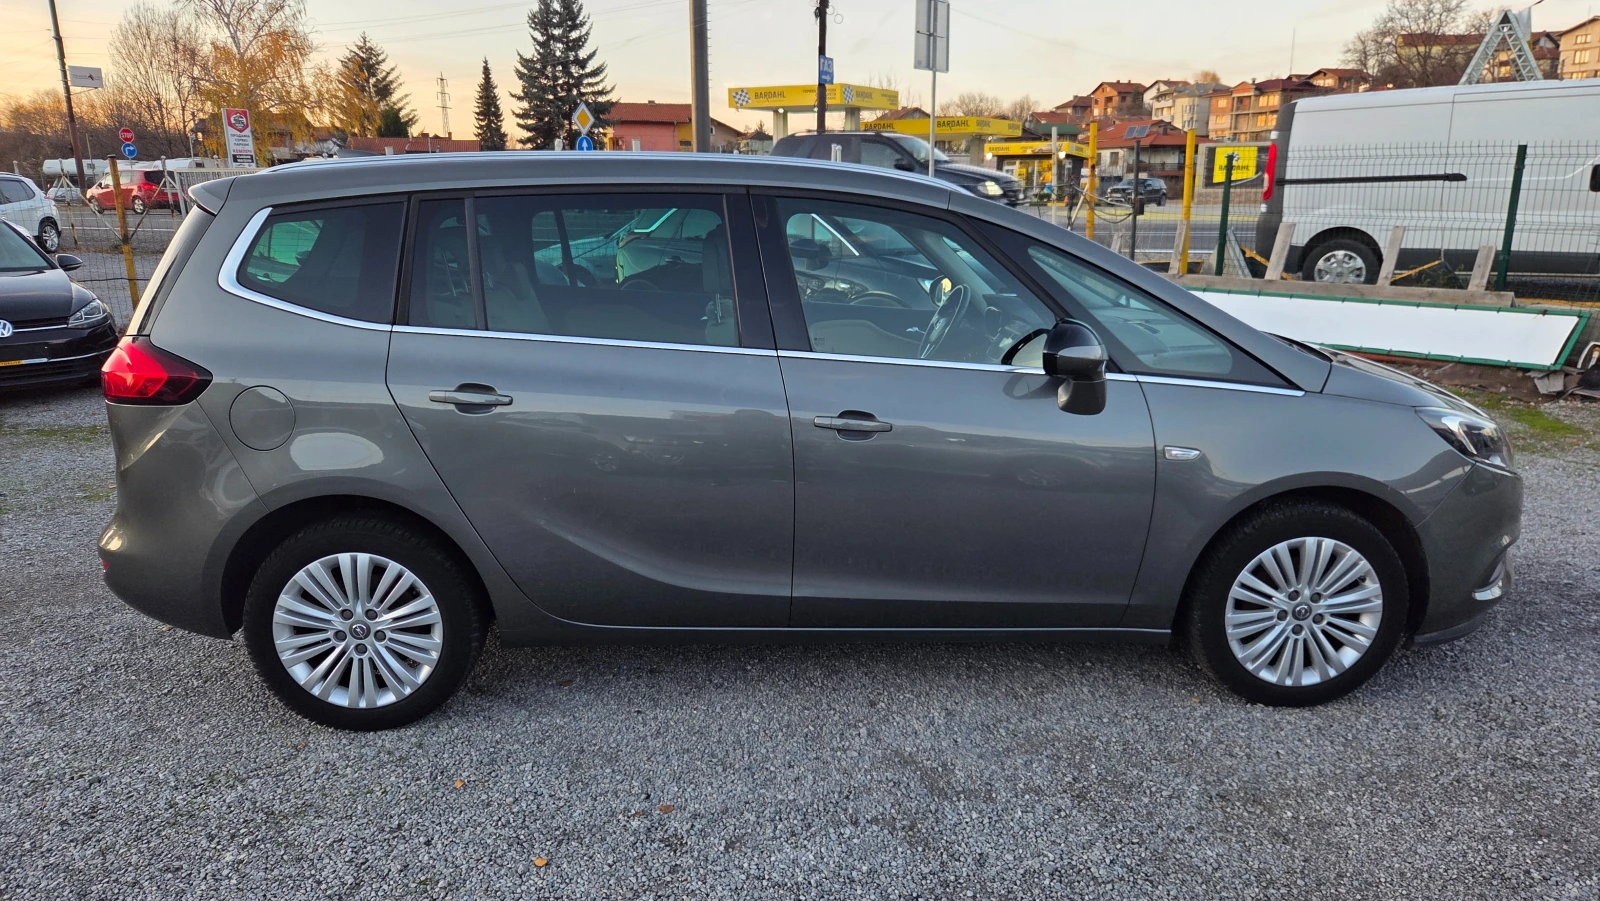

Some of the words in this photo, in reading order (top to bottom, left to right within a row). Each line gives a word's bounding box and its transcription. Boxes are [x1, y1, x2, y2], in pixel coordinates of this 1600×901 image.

[754, 91, 786, 102] BARDAHL
[864, 123, 896, 131] BARDAHL
[936, 119, 971, 131] BARDAHL
